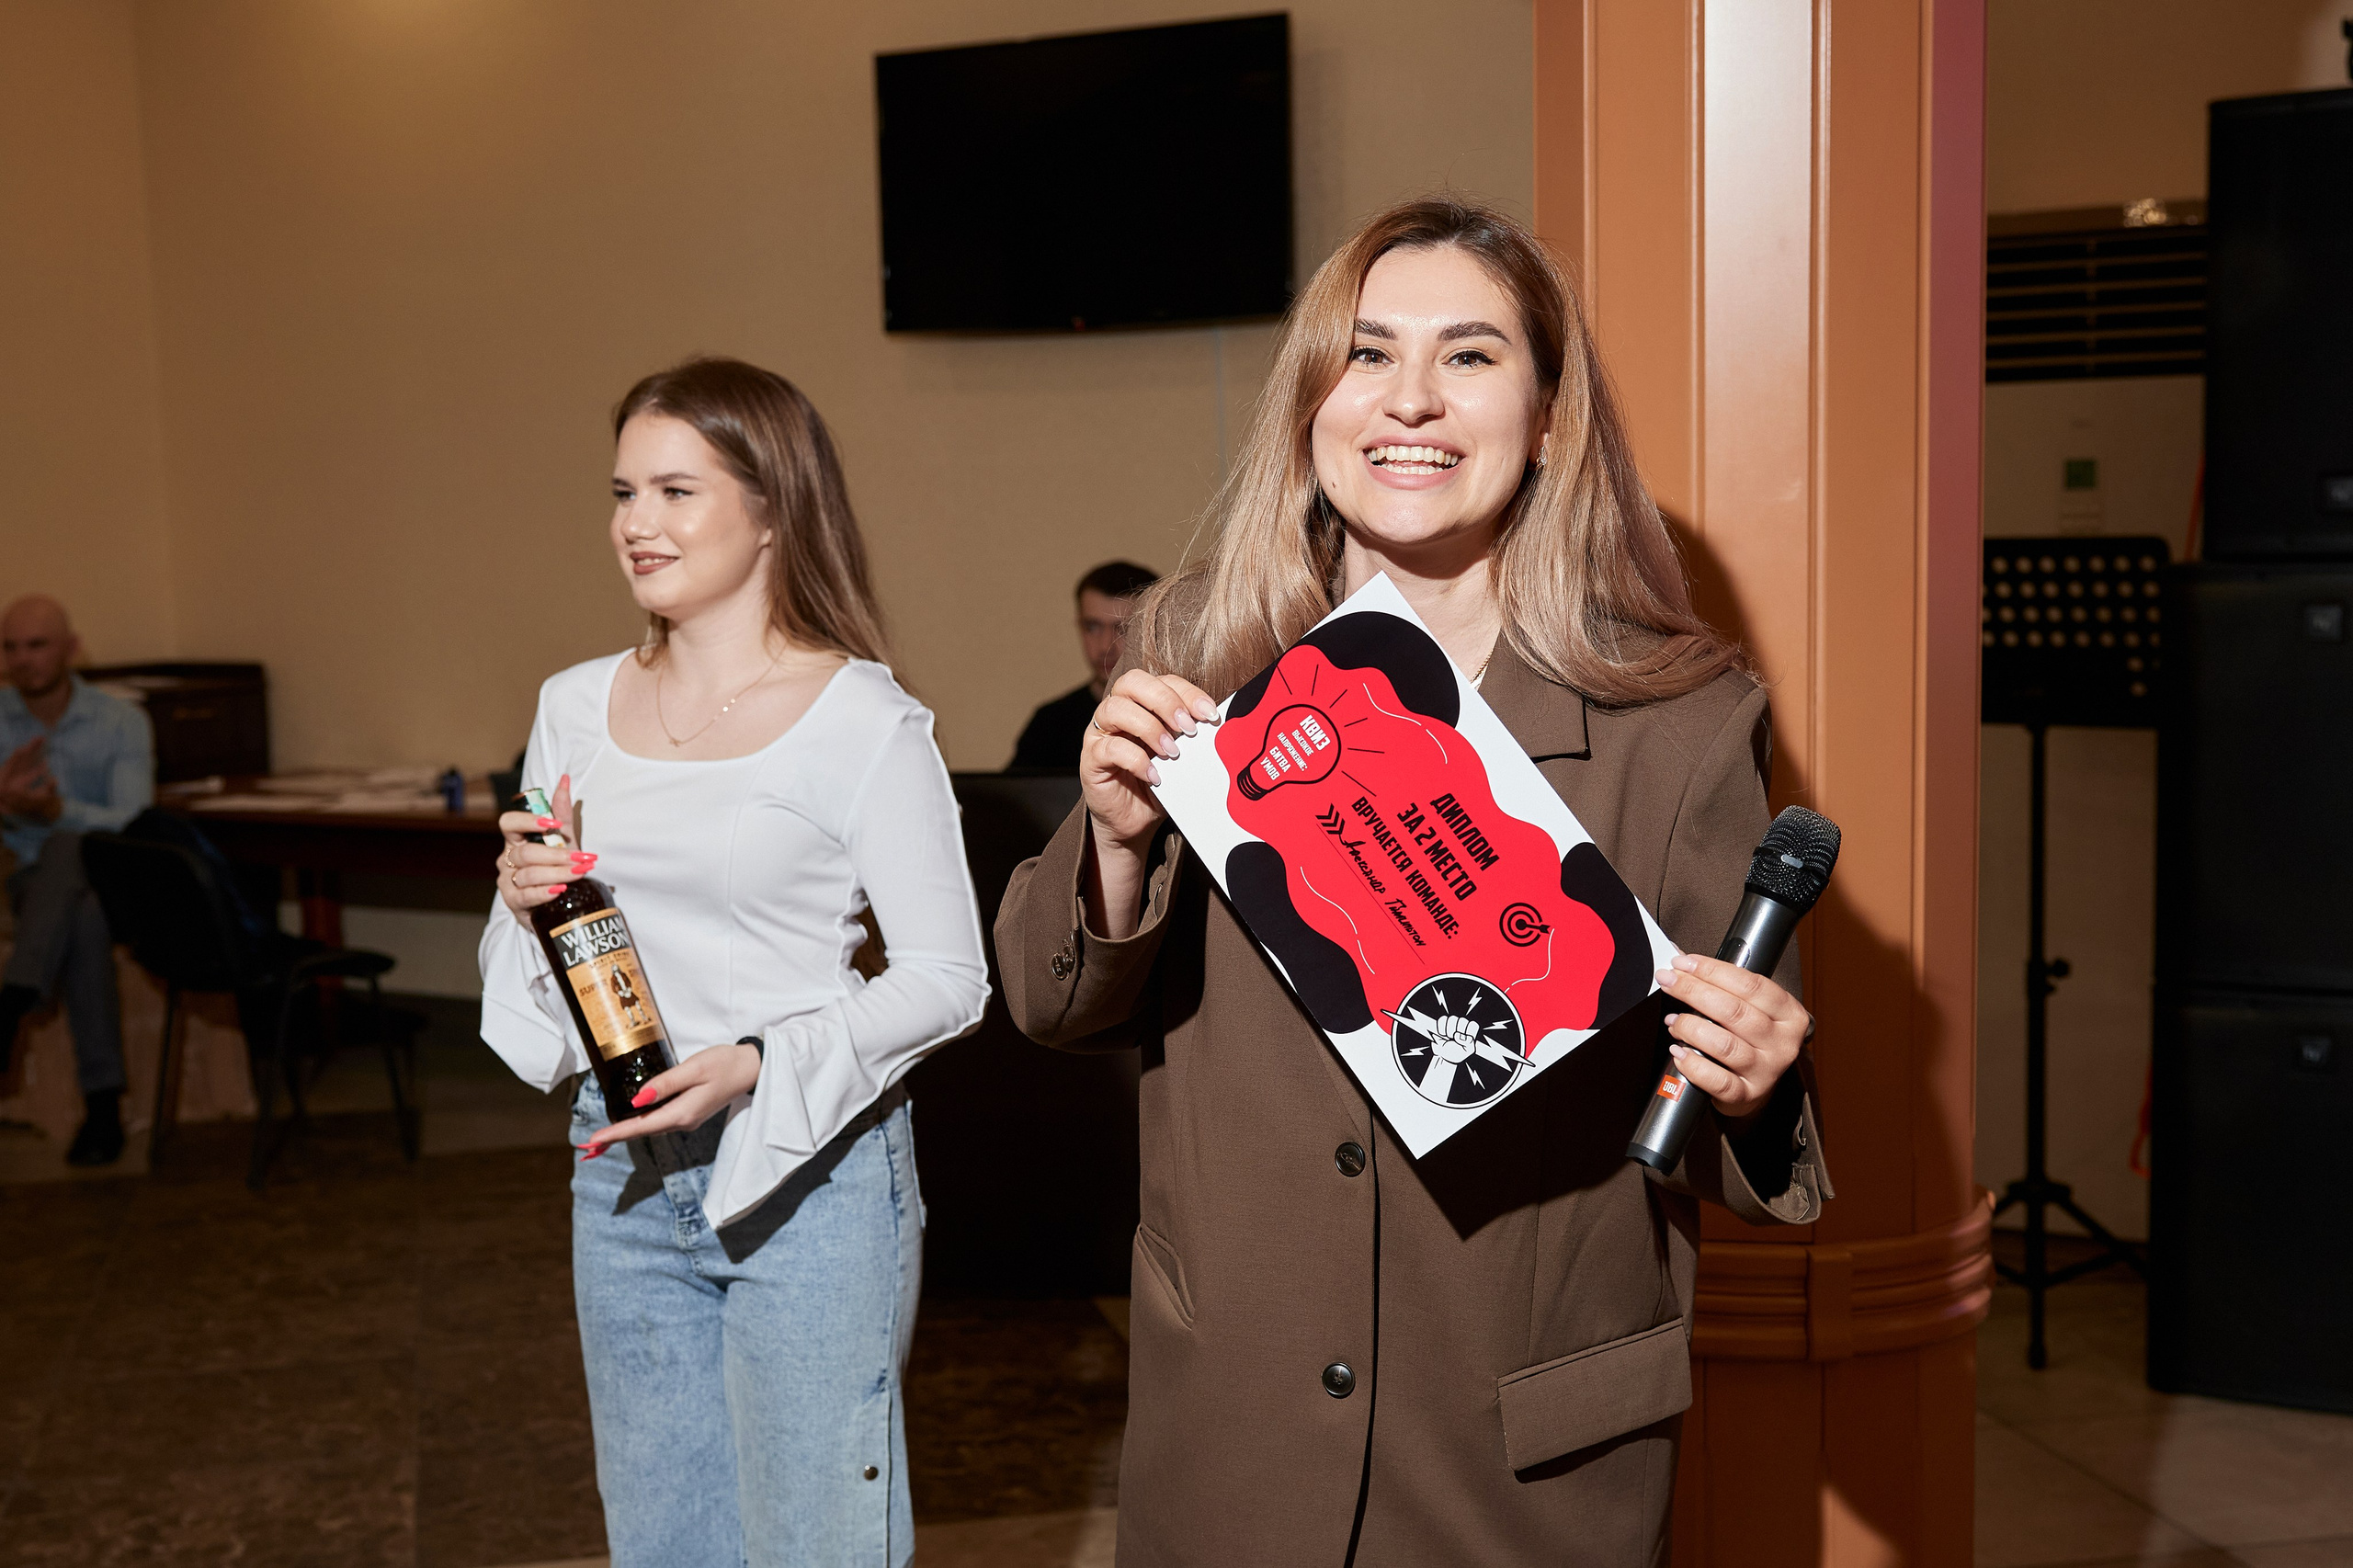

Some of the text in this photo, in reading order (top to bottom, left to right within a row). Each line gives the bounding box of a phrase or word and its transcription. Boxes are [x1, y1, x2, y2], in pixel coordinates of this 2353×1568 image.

[1291, 729, 1314, 756] ВЫСОКОЕ
[1299, 714, 1331, 751] КВИЗ
[1259, 756, 1280, 780] УМОВ
[1268, 745, 1291, 773] БИТВА
[1277, 732, 1308, 772] НАПРЯЖЕНИЕ:
[1429, 792, 1500, 871] ДИПЛОМ
[1351, 796, 1460, 939] ВРУЧАЕТСЯ КОМАНДЕ:
[1396, 802, 1478, 902] ЗА 2 МЕСТО
[1663, 1080, 1677, 1096] JBL
